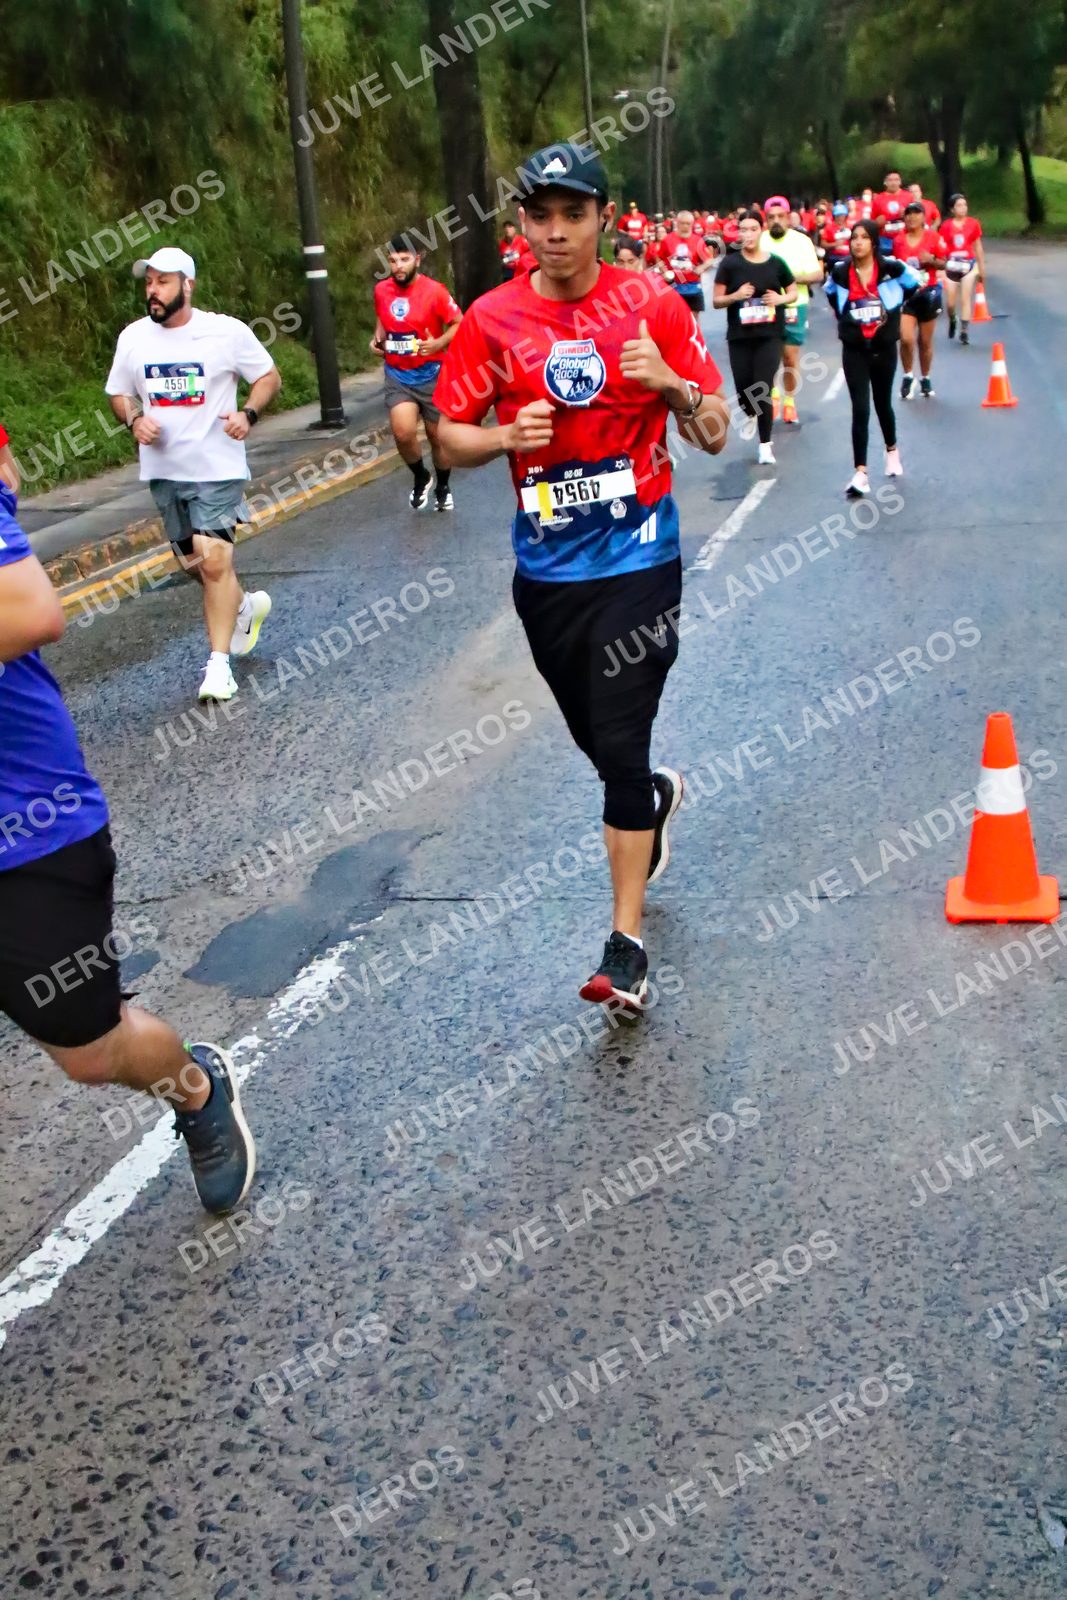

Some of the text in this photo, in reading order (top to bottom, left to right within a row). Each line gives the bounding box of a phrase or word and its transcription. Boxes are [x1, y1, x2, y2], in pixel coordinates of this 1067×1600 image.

[559, 357, 590, 369] Global
[554, 369, 579, 380] Race
[164, 379, 187, 390] 4551
[552, 479, 601, 506] 4954
